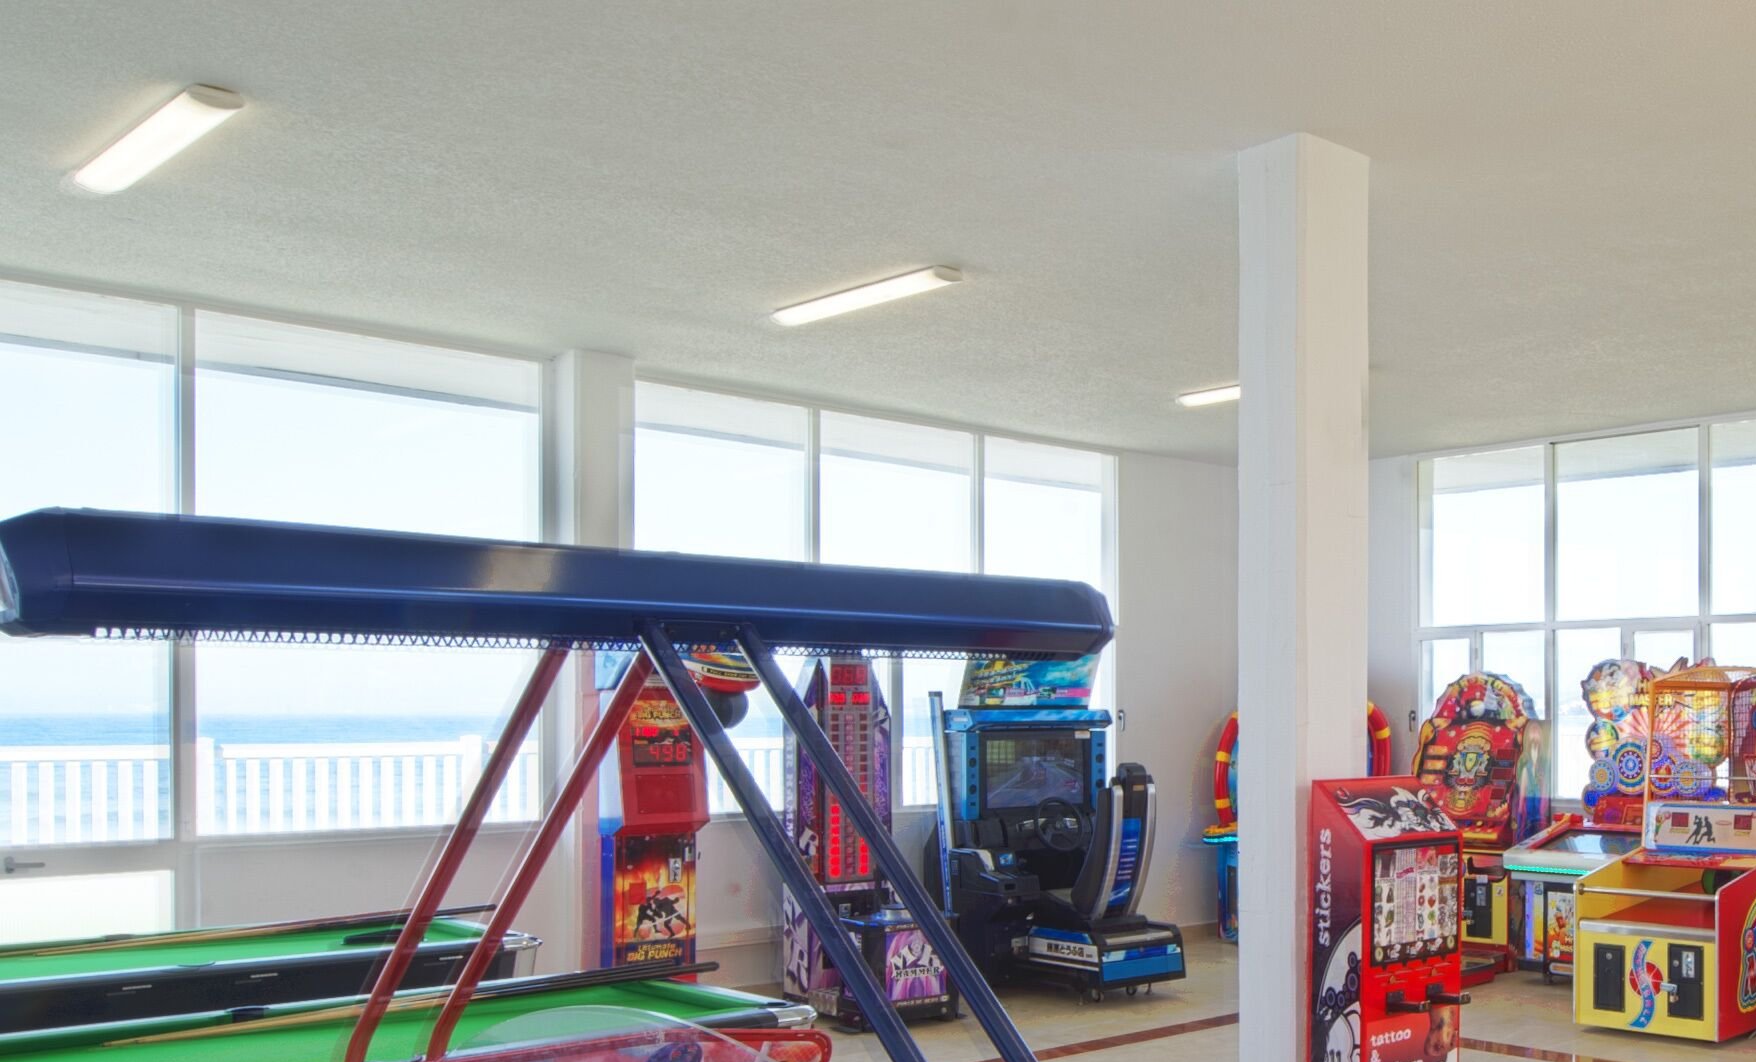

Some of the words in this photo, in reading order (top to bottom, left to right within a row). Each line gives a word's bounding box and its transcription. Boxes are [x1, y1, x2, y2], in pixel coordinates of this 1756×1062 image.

[1315, 828, 1332, 947] stickers
[648, 948, 683, 960] PUNCH
[1370, 1028, 1412, 1047] tattoo
